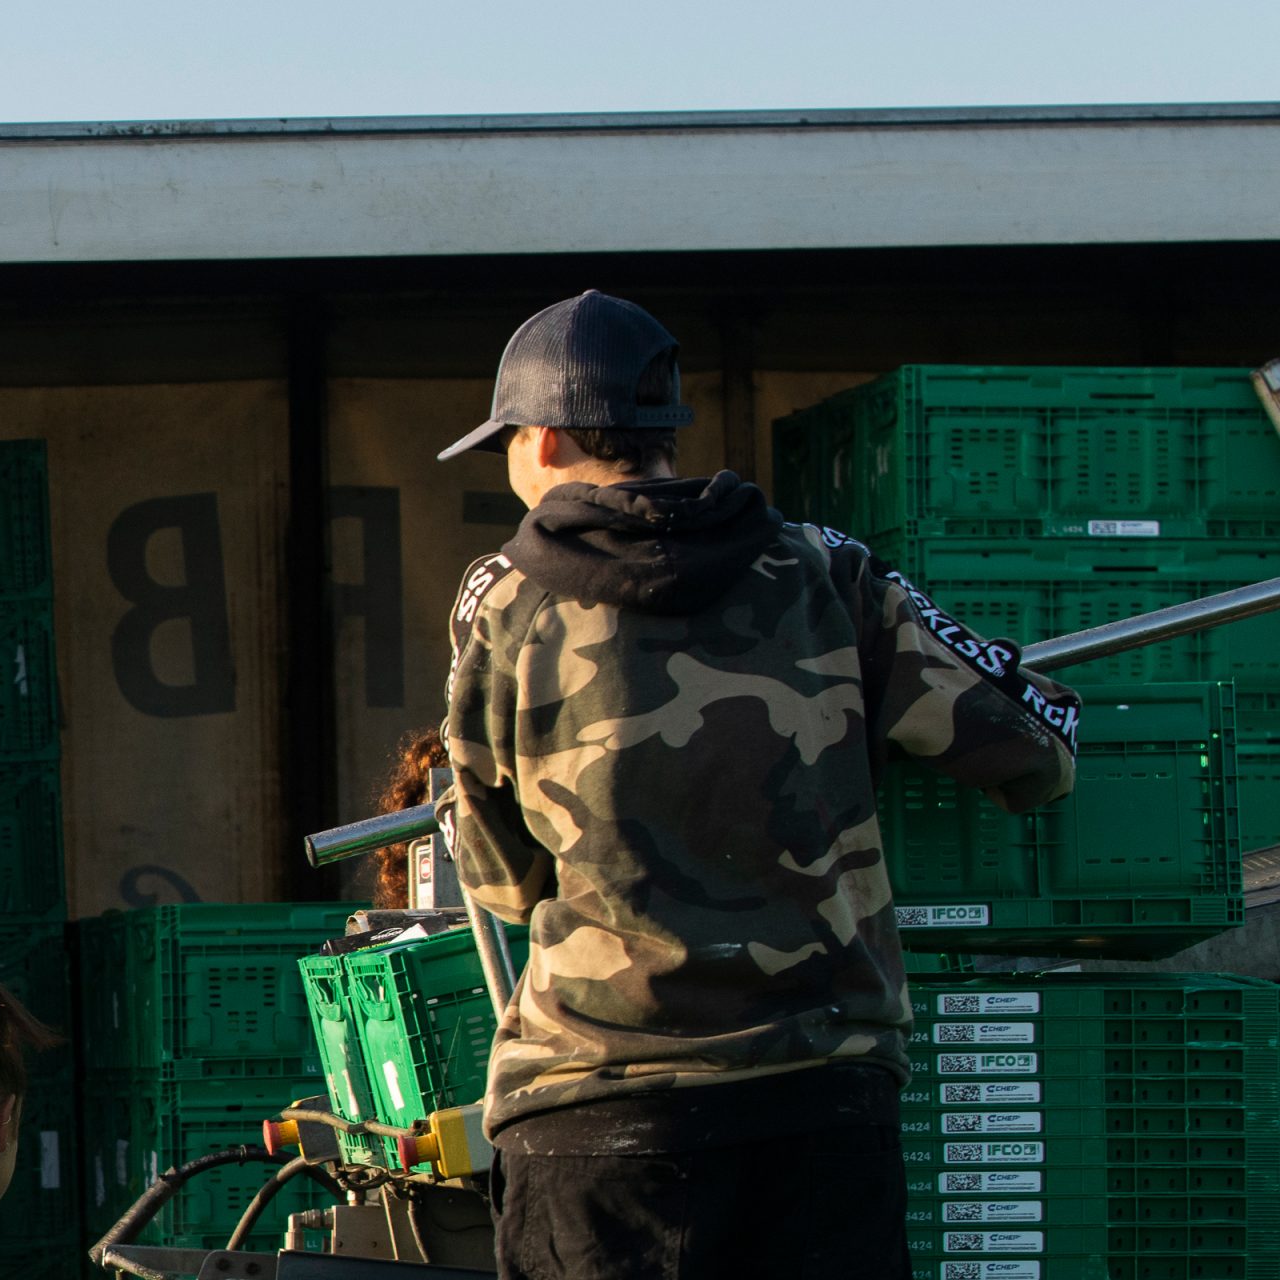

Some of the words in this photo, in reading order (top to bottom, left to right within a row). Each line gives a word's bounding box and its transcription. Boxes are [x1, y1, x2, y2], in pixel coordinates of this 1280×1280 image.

[932, 907, 967, 920] IFCO
[981, 1055, 1016, 1067] IFCO
[900, 1092, 930, 1103] 6424
[901, 1122, 930, 1132] 6424
[987, 1144, 1022, 1155] IFCO
[902, 1151, 931, 1162] 6424
